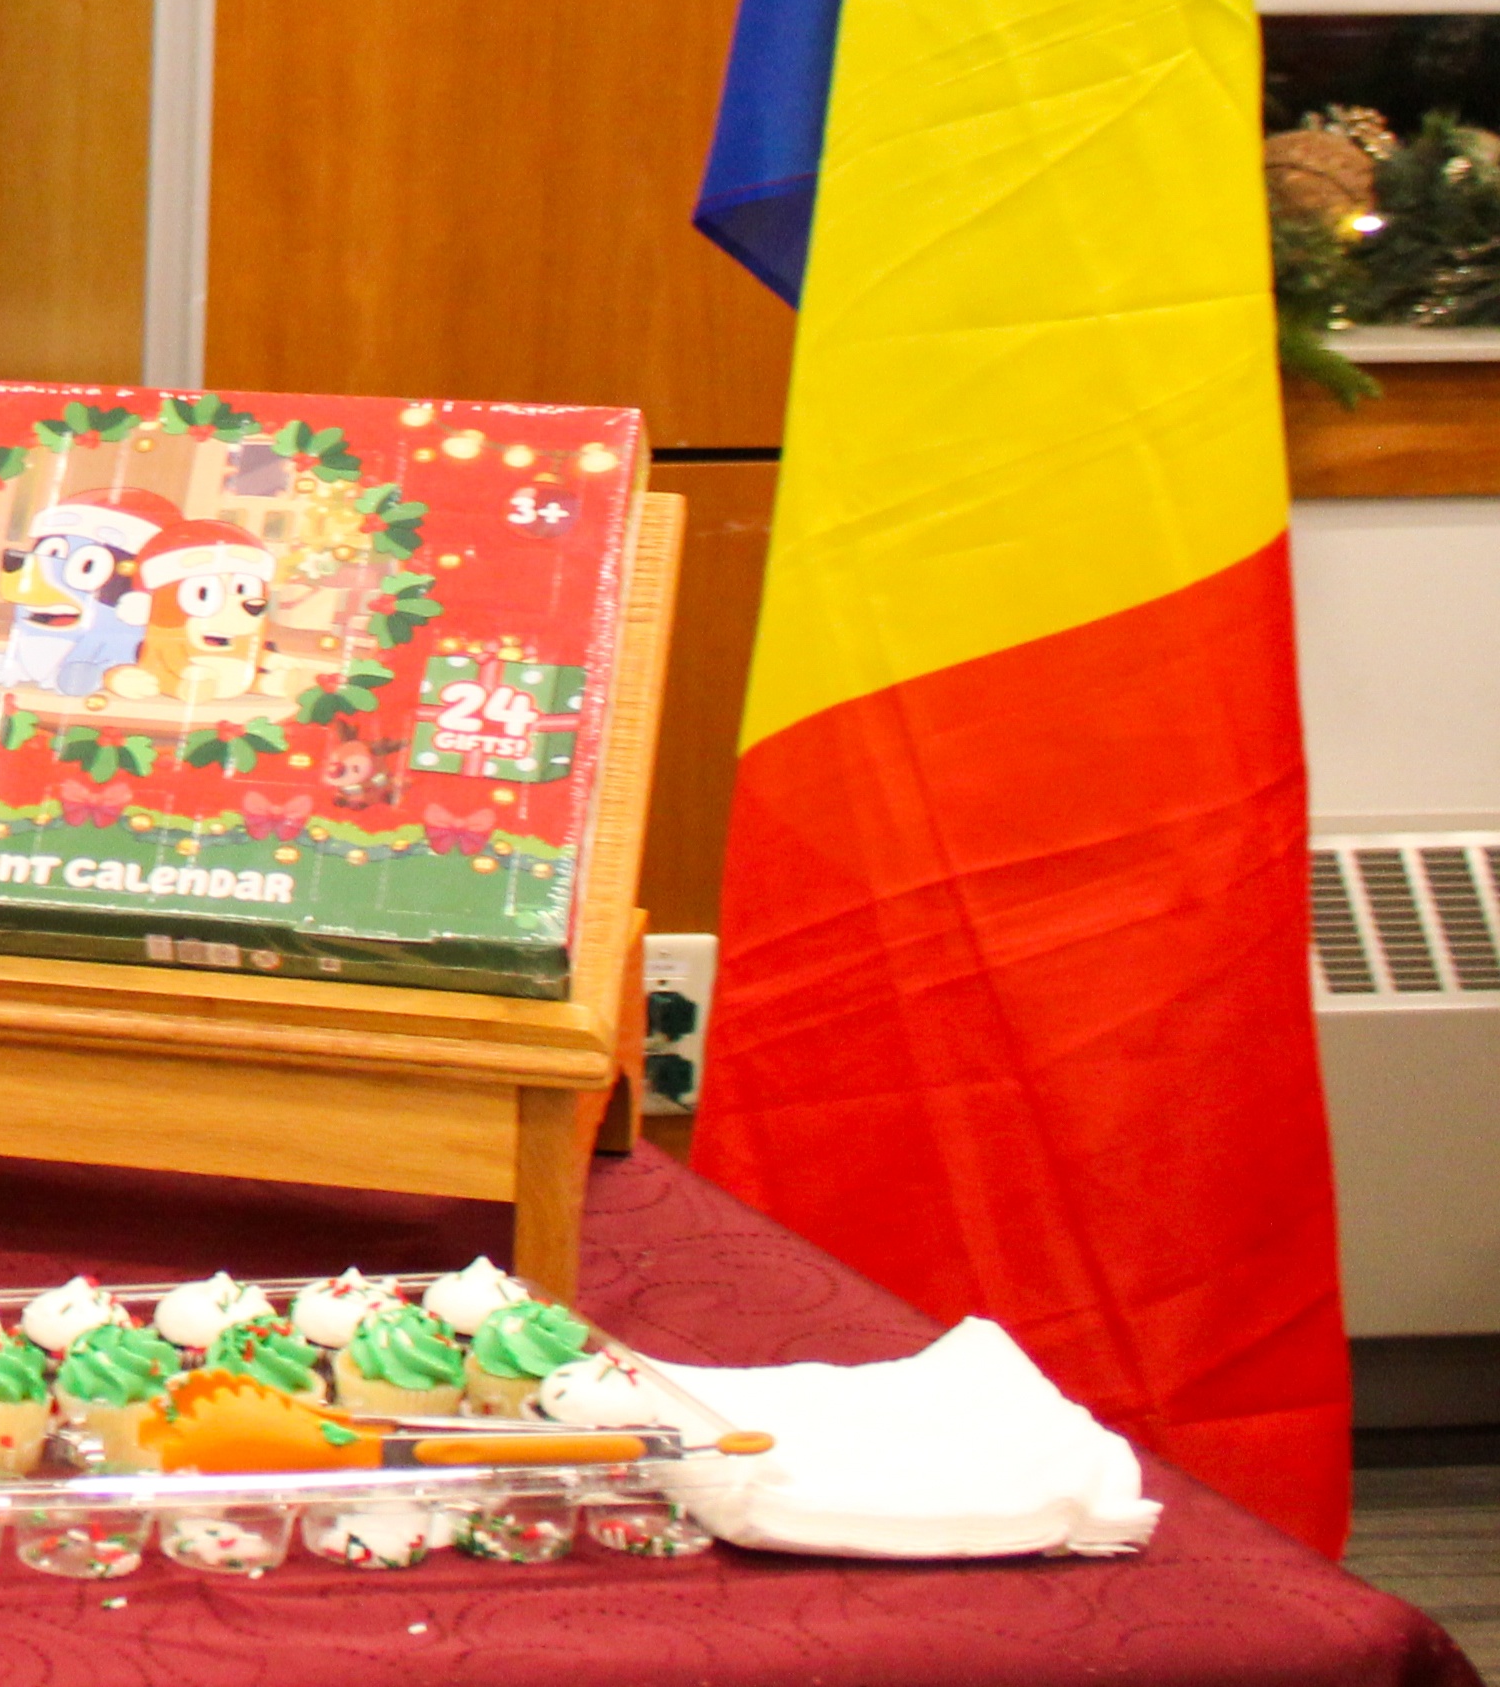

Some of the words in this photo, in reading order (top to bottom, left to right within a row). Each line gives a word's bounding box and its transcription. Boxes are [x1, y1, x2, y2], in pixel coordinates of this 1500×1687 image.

[507, 496, 570, 524] 3+
[437, 681, 539, 737] 24
[434, 732, 528, 758] GIFTS!
